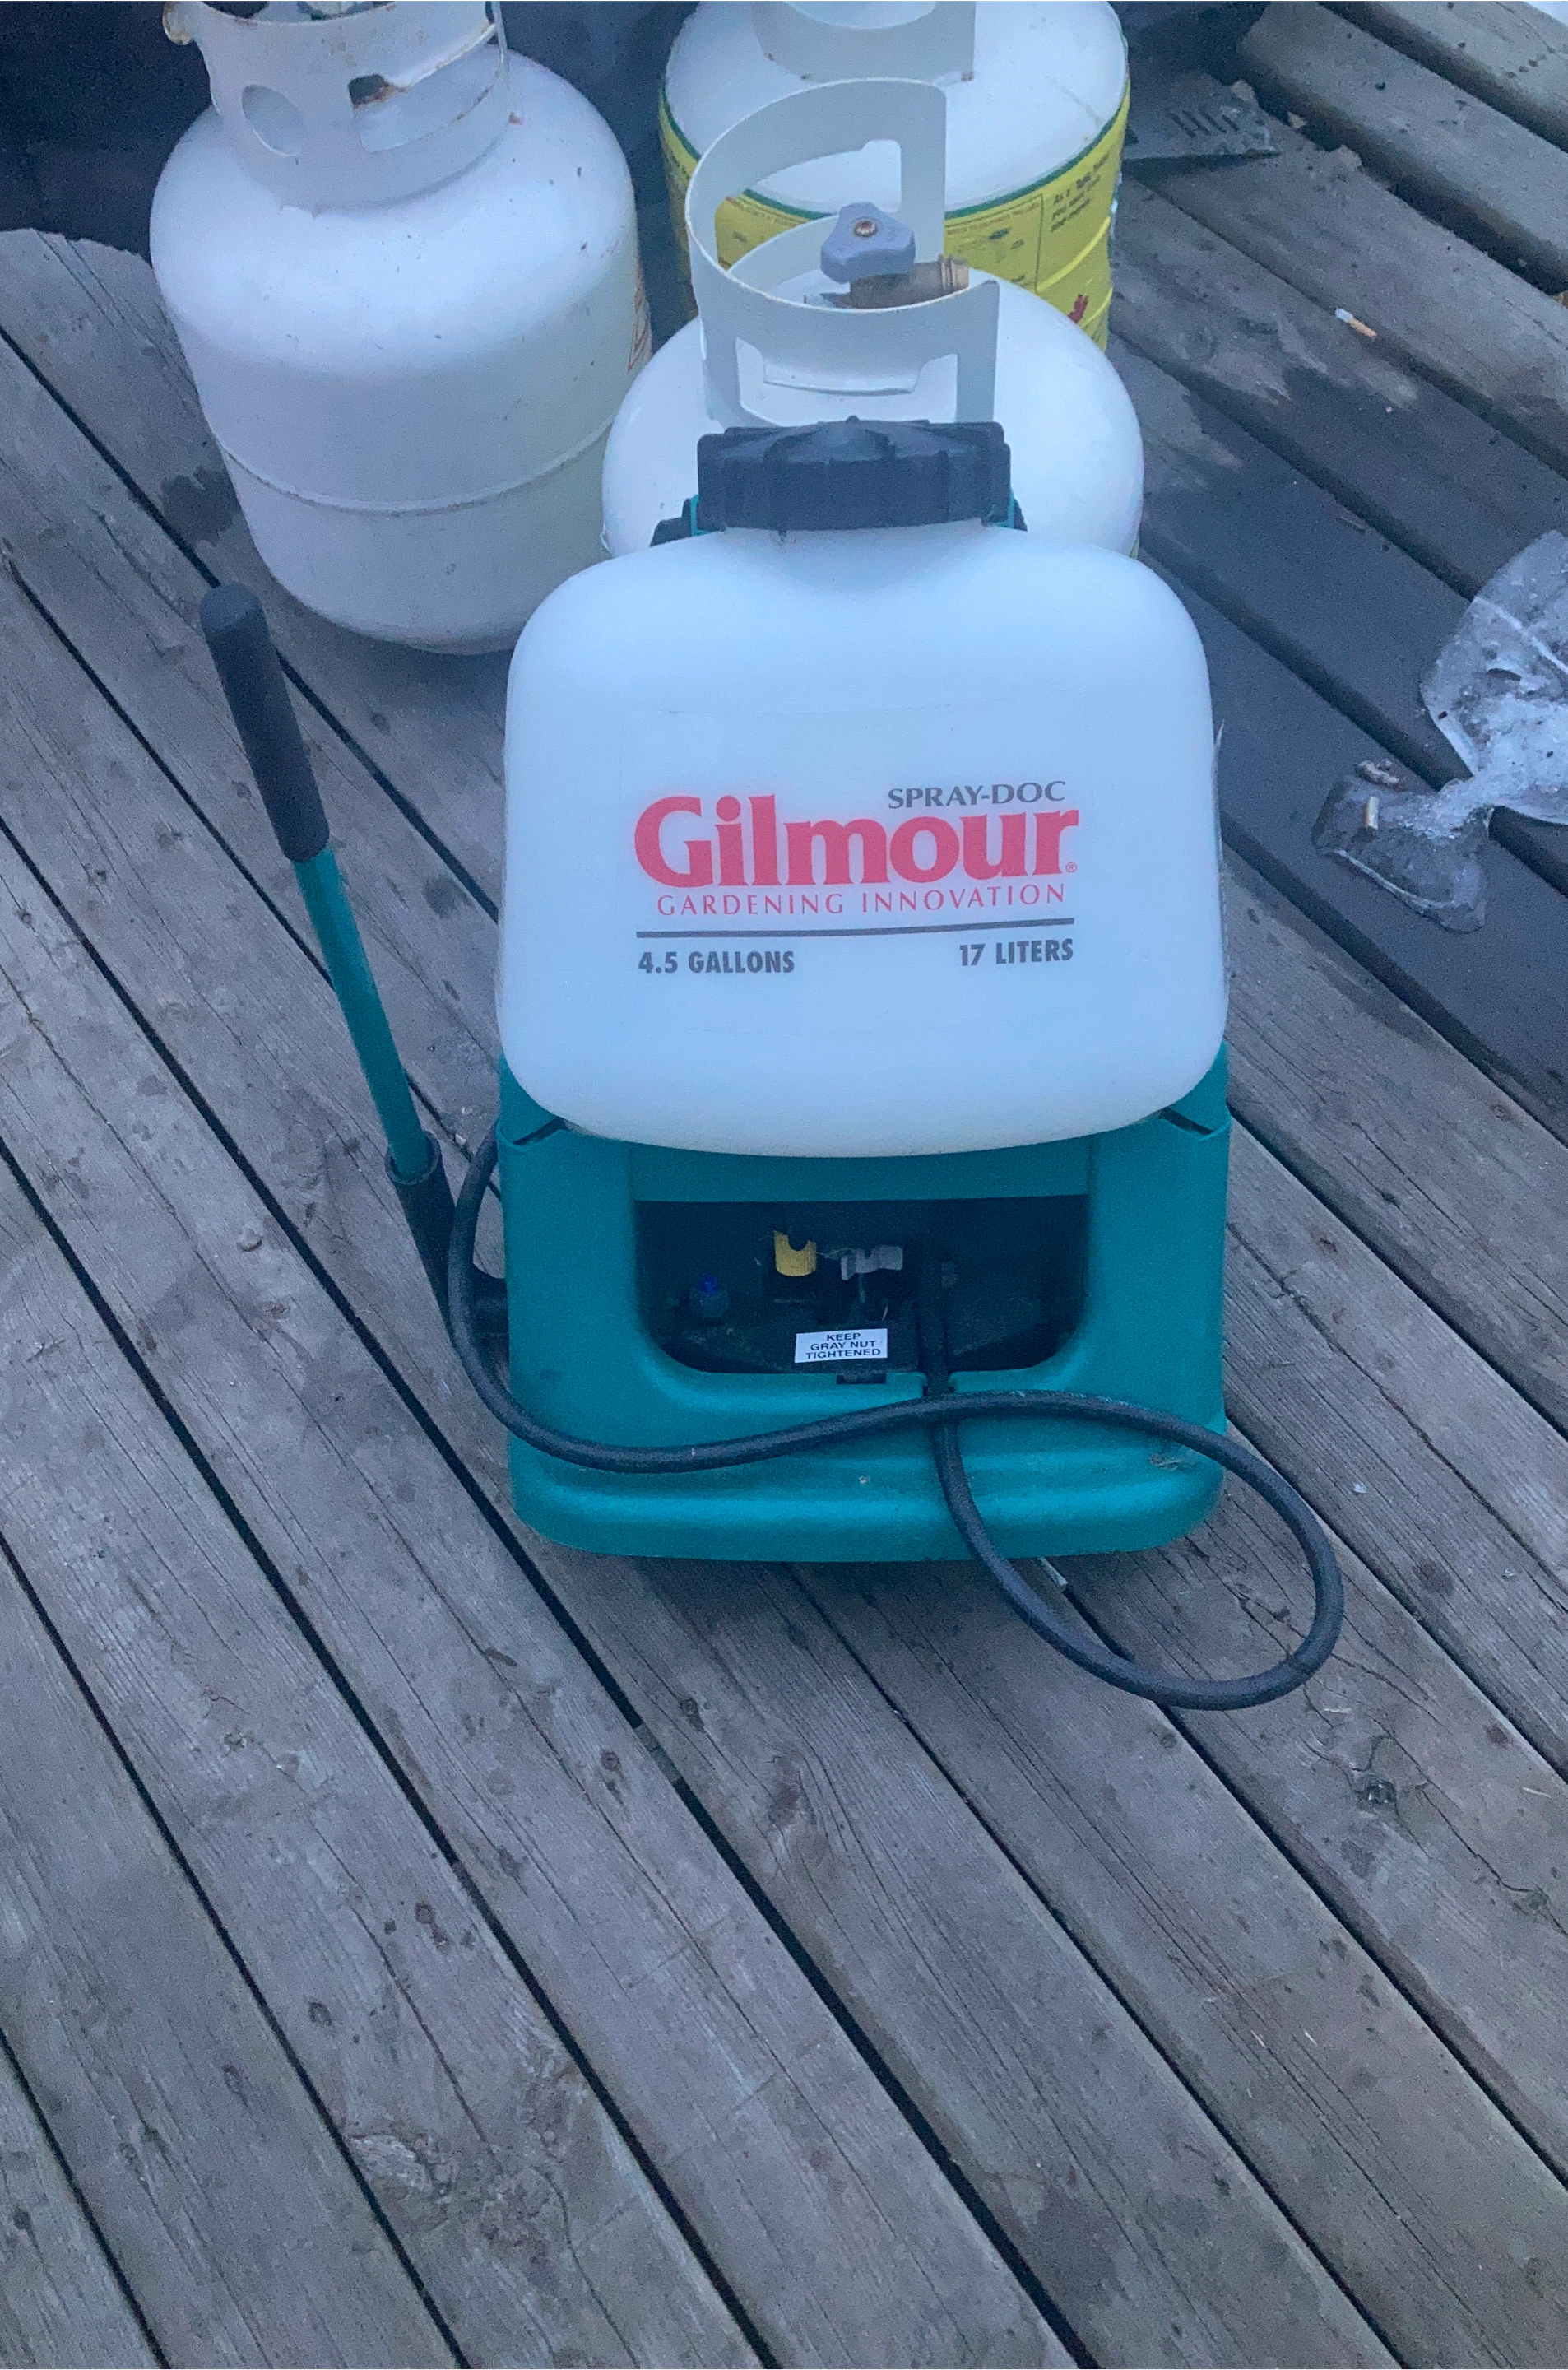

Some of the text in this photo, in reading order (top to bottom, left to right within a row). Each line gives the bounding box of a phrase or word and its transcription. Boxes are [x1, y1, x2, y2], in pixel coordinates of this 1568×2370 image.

[888, 780, 1067, 810] SPRAY-DOC
[634, 793, 1079, 889] Gilmour
[657, 883, 1065, 916] GARDENING INNOVATION
[638, 950, 796, 974] 4.5 GALLONS
[959, 938, 1074, 967] 17 LITERS
[810, 1340, 877, 1351] GRAY NUT
[826, 1332, 861, 1341] KEEP
[806, 1348, 881, 1359] TIGHTENED
